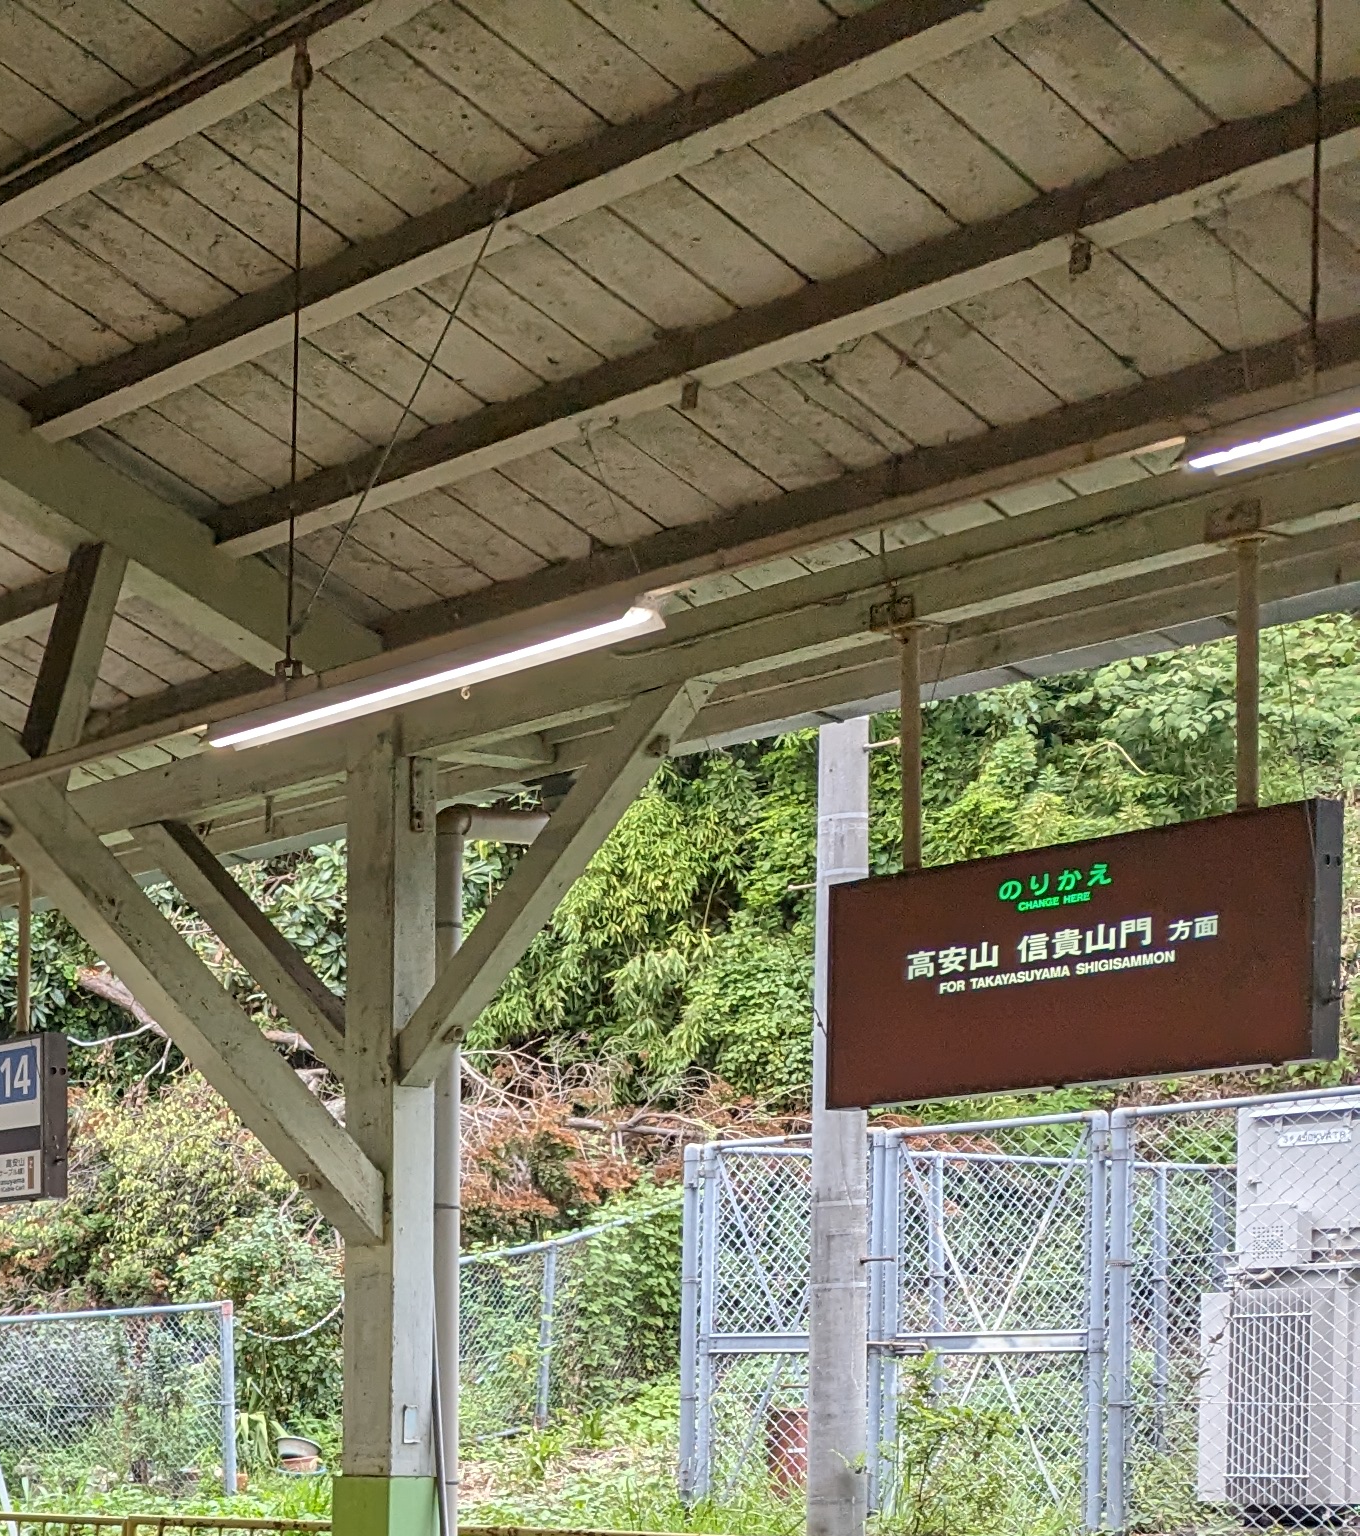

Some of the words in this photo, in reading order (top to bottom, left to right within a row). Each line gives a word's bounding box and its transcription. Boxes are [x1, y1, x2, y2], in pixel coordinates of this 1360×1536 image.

[999, 861, 1112, 901] のりかえ
[1018, 896, 1059, 912] CHANGE
[1063, 891, 1091, 905] HERE
[906, 941, 1000, 981] 高安山
[1018, 917, 1153, 964] 信貴山門
[1169, 914, 1219, 942] 方面
[939, 979, 966, 995] FOR
[970, 964, 1071, 991] TAKAYASUYAMA
[1075, 949, 1176, 976] SHIGISAMMON
